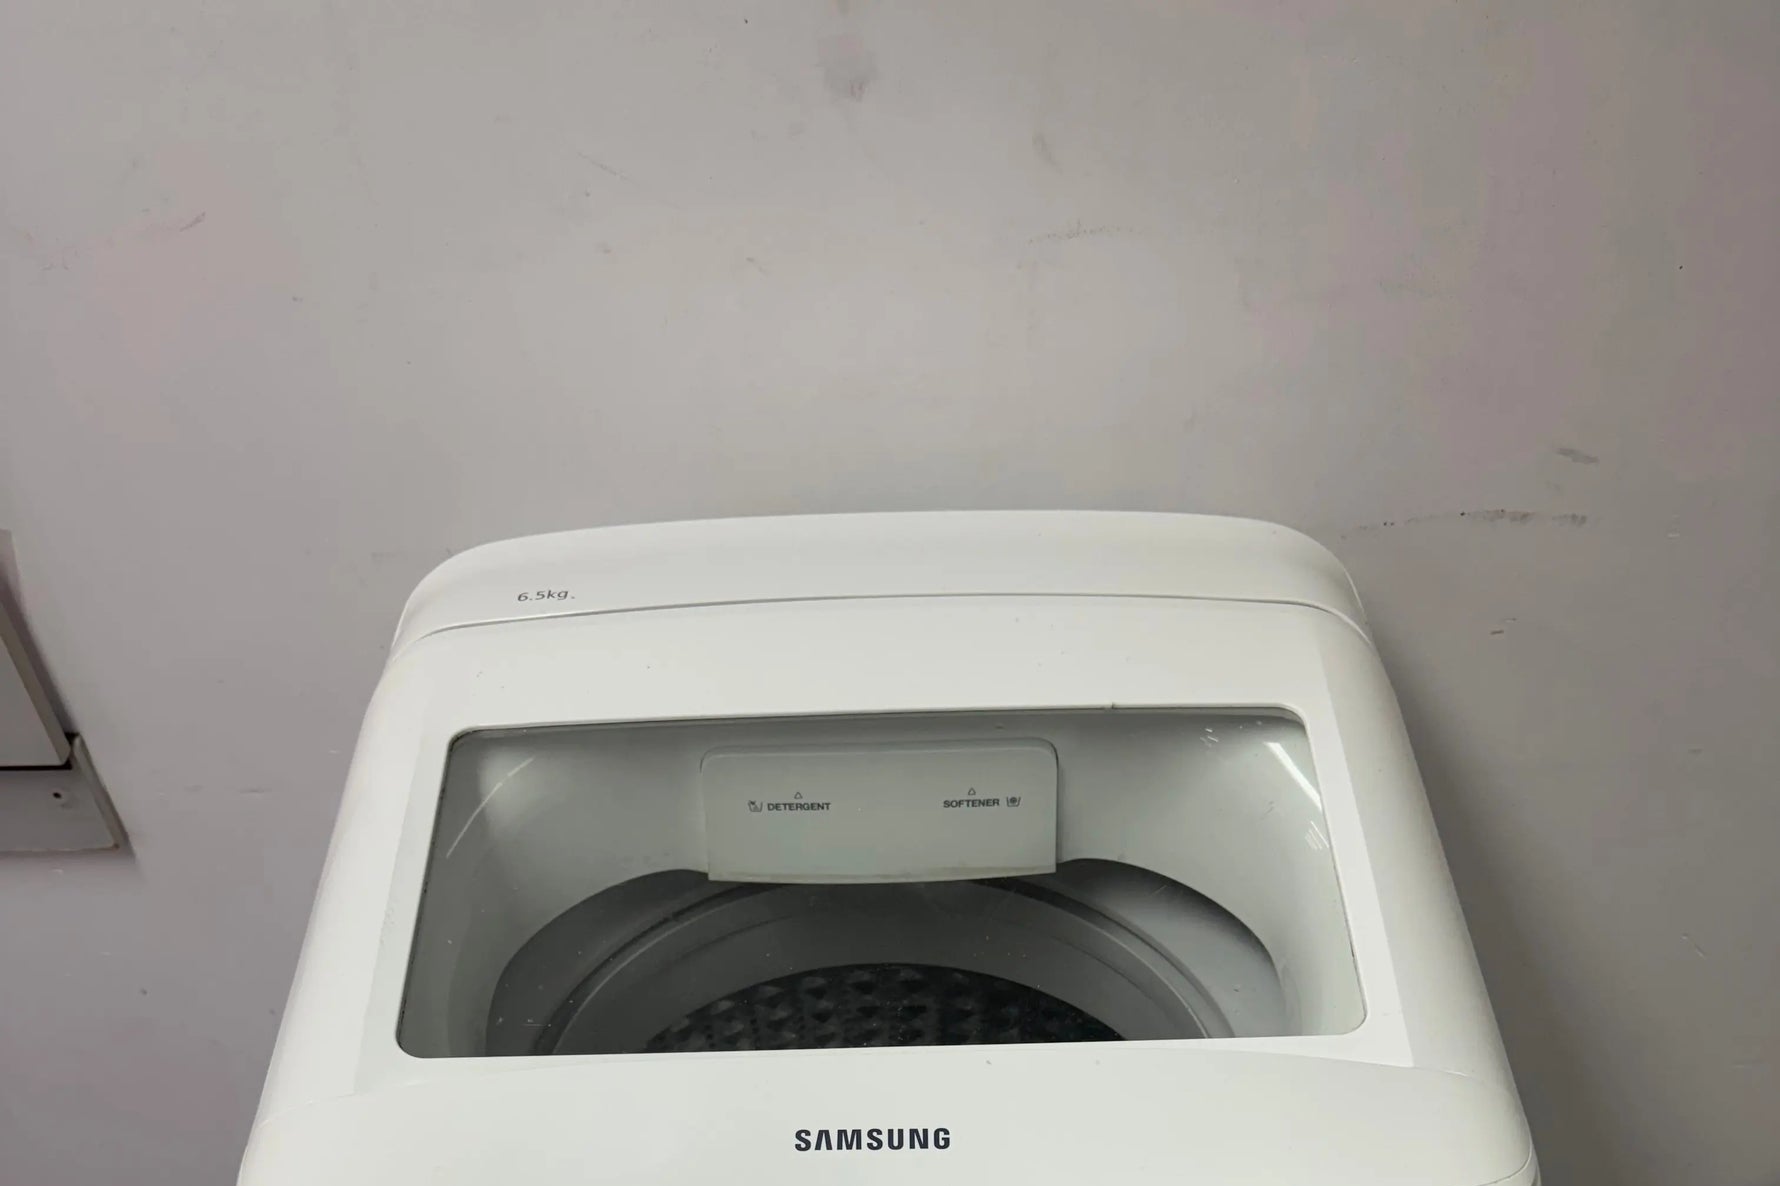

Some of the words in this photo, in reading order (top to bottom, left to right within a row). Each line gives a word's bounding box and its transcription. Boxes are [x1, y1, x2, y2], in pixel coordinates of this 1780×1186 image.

[767, 802, 831, 812] DETERGENT
[943, 798, 1000, 809] SOFTENER
[795, 1128, 951, 1152] SAMSUNG
